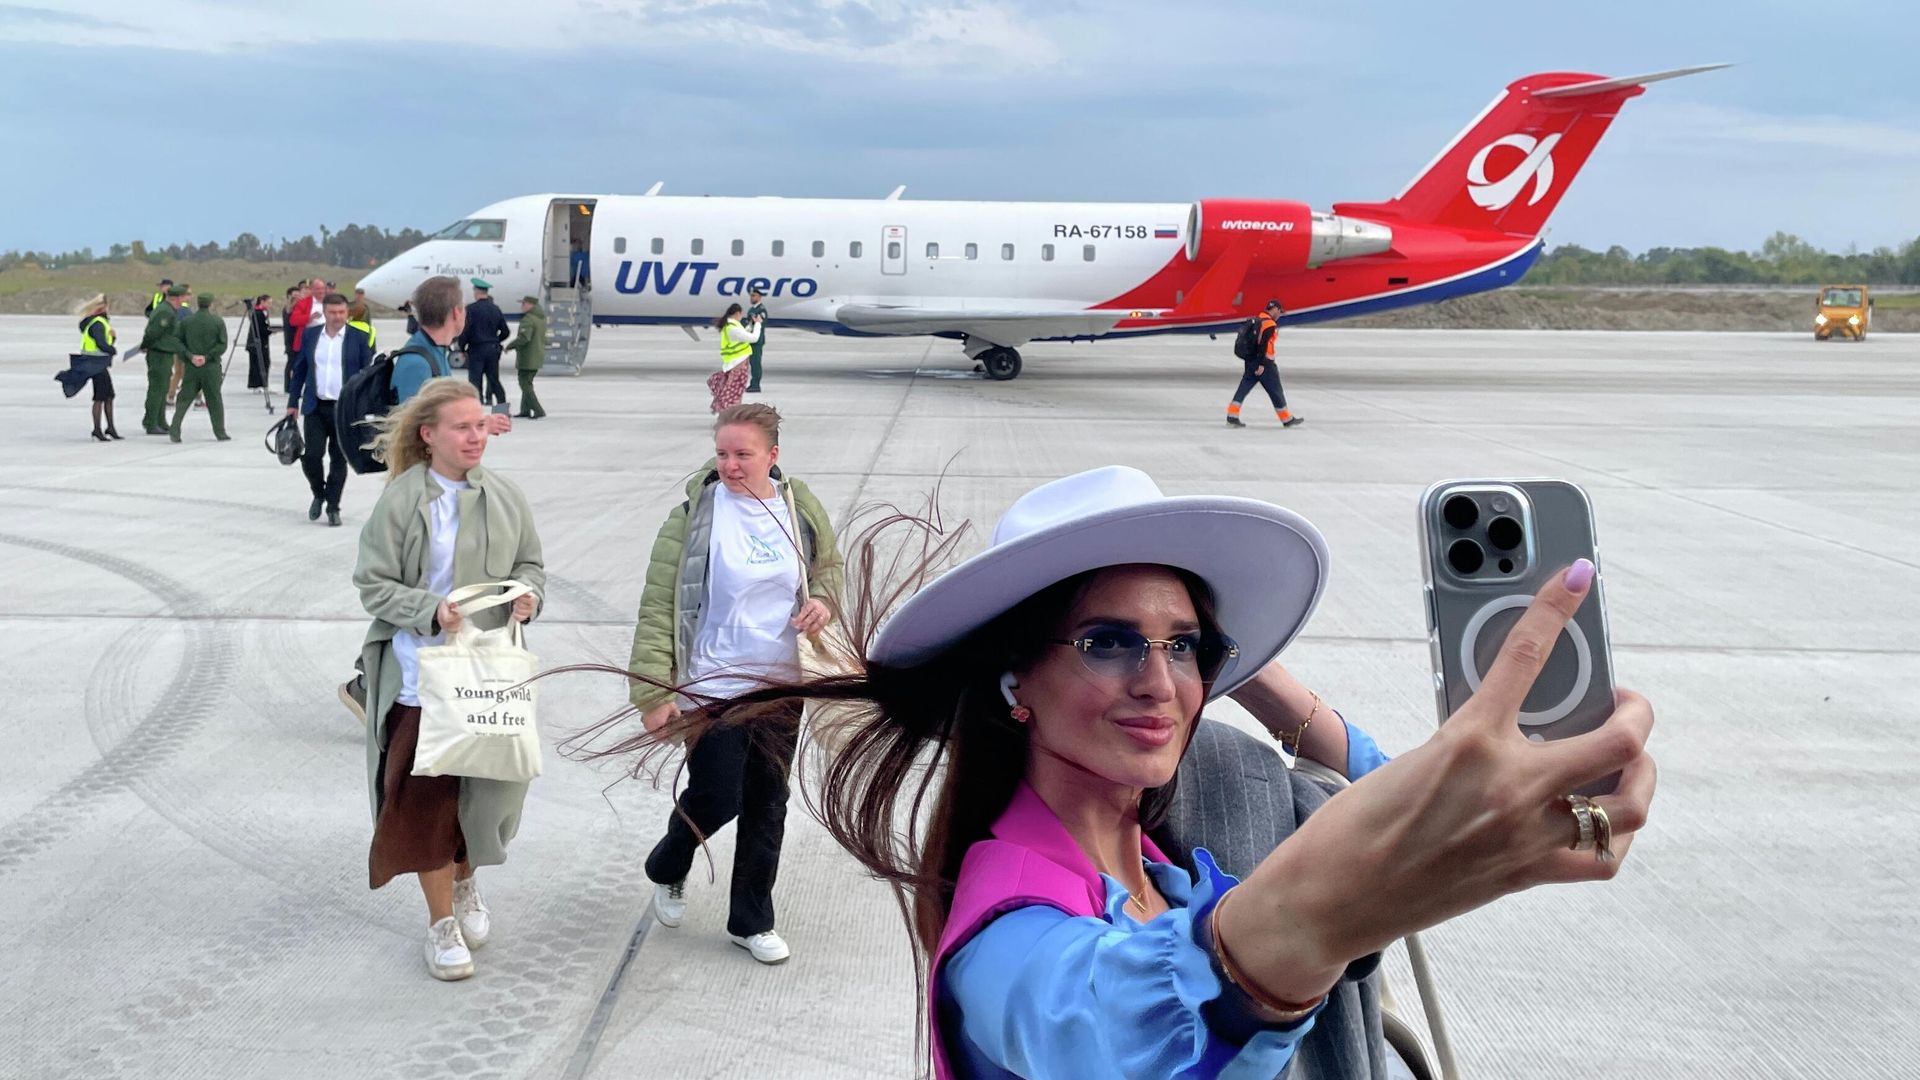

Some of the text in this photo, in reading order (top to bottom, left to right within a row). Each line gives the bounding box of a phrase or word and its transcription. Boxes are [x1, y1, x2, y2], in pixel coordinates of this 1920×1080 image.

[1054, 224, 1148, 239] RA-67158
[1221, 219, 1295, 232] uvtaero.ru
[614, 260, 818, 298] UVT aero
[1084, 638, 1094, 652] F
[454, 686, 532, 704] Young, wild
[466, 711, 526, 726] and free
